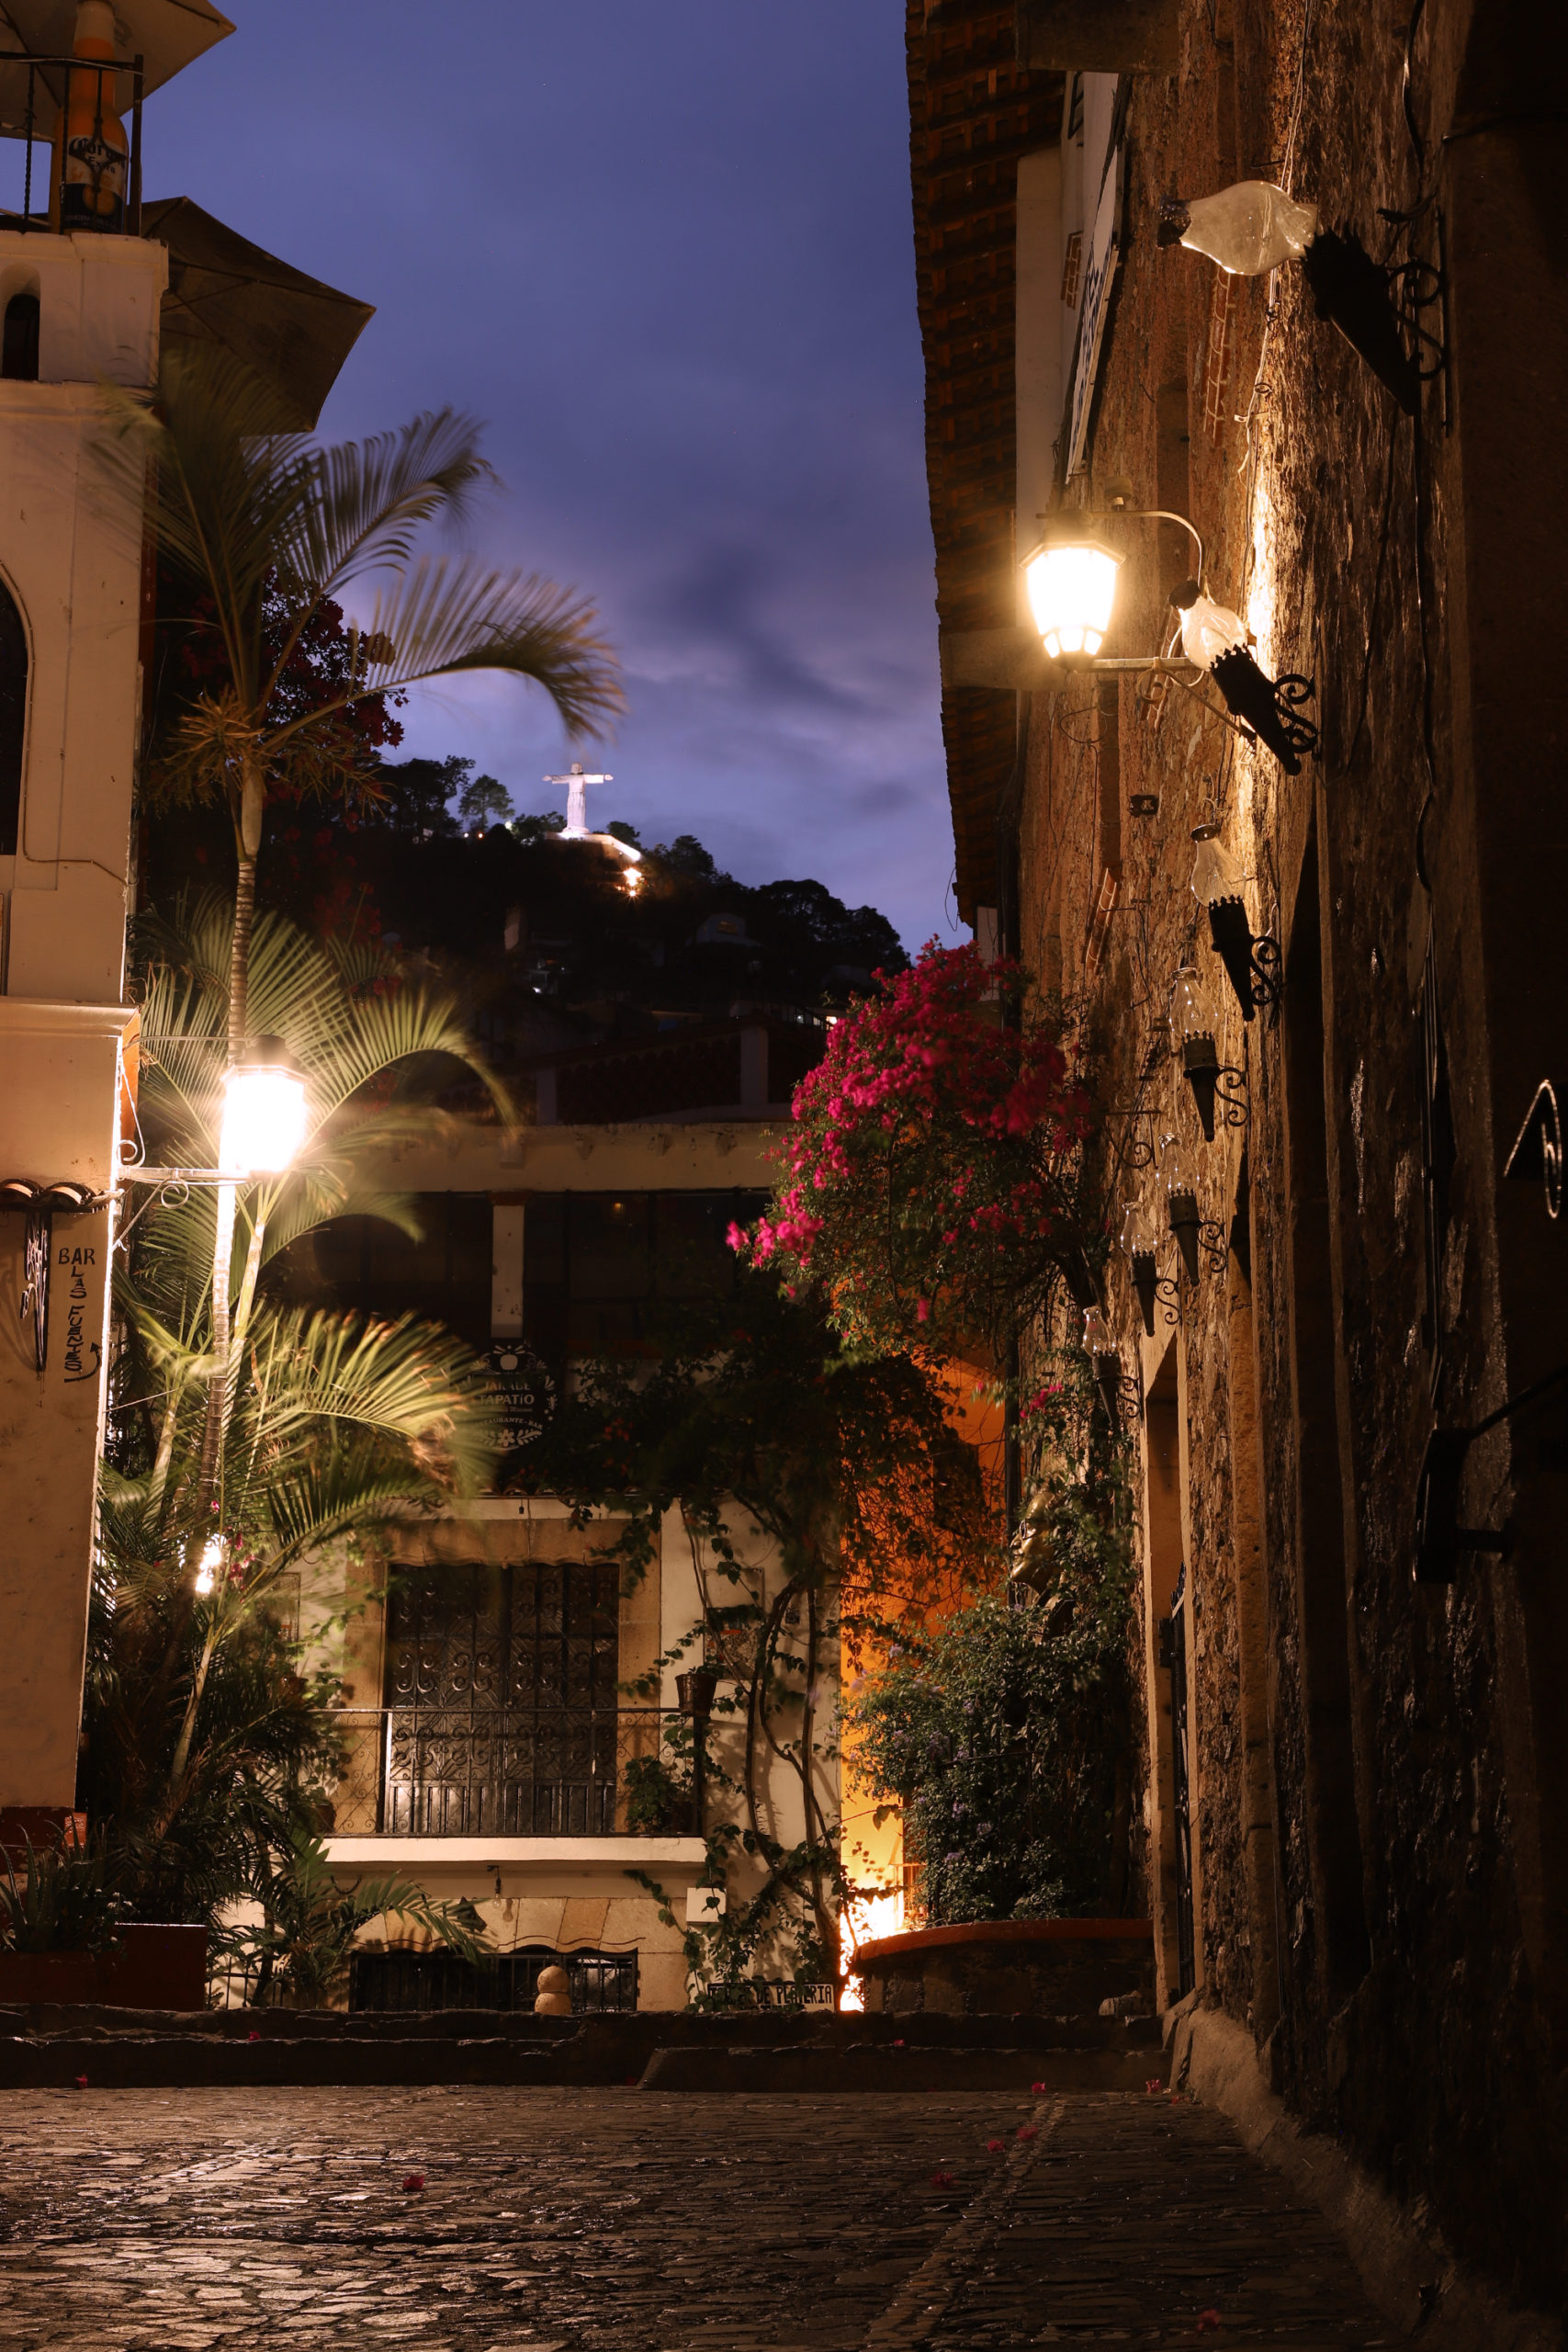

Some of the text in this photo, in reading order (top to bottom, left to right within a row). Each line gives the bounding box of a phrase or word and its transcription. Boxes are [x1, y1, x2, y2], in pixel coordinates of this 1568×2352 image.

[59, 1248, 95, 1265] BAR
[64, 1265, 87, 1372] LAS FUENTES
